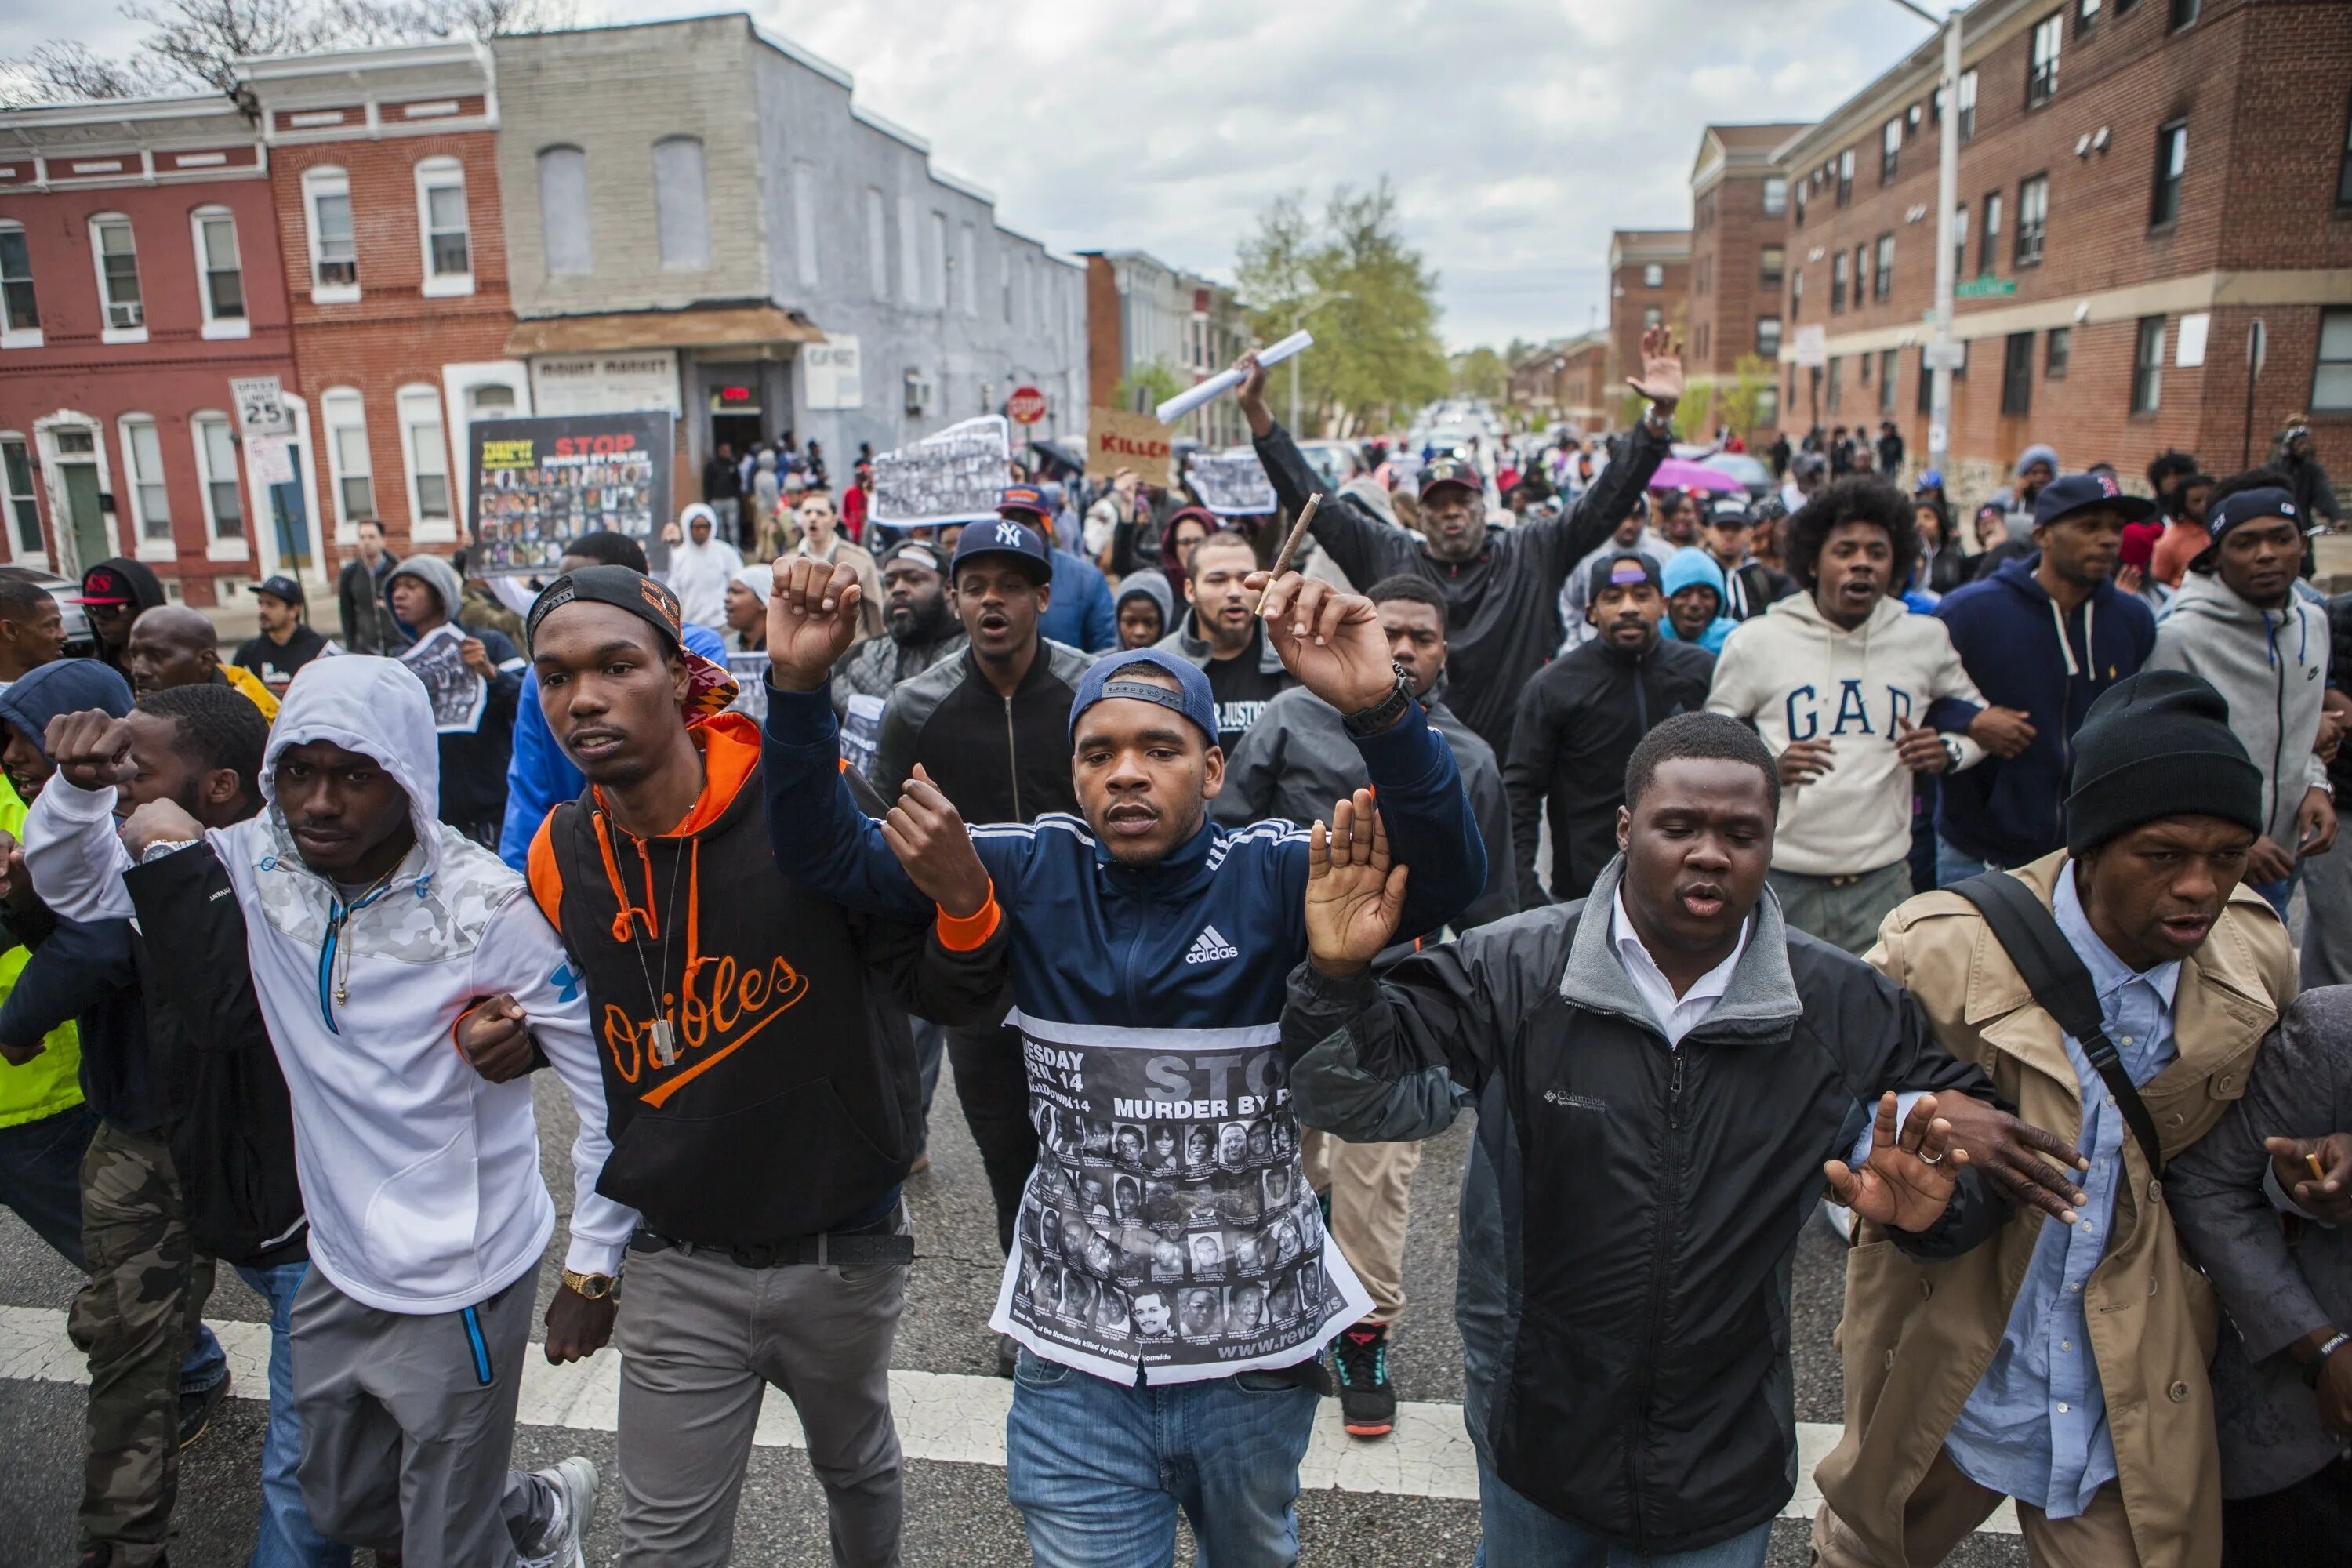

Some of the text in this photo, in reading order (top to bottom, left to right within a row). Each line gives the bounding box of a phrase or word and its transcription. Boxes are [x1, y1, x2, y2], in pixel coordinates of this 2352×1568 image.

[245, 403, 280, 423] 25
[1009, 398, 1044, 413] STOP
[554, 434, 636, 456] STOP
[1786, 680, 1911, 741] GAP
[1185, 946, 1239, 964] adidas
[1022, 1036, 1084, 1071] UESDAY
[1025, 1055, 1083, 1092] PRIL 14
[1145, 1051, 1285, 1103] STO
[1113, 1098, 1228, 1119] MURDER
[1238, 1095, 1269, 1115] BY
[1557, 1091, 1606, 1106] Columbia
[1044, 1327, 1052, 1336] the
[1052, 1330, 1081, 1345] thousands
[1082, 1340, 1099, 1352] killed
[1100, 1345, 1109, 1354] by
[1109, 1348, 1129, 1359] police
